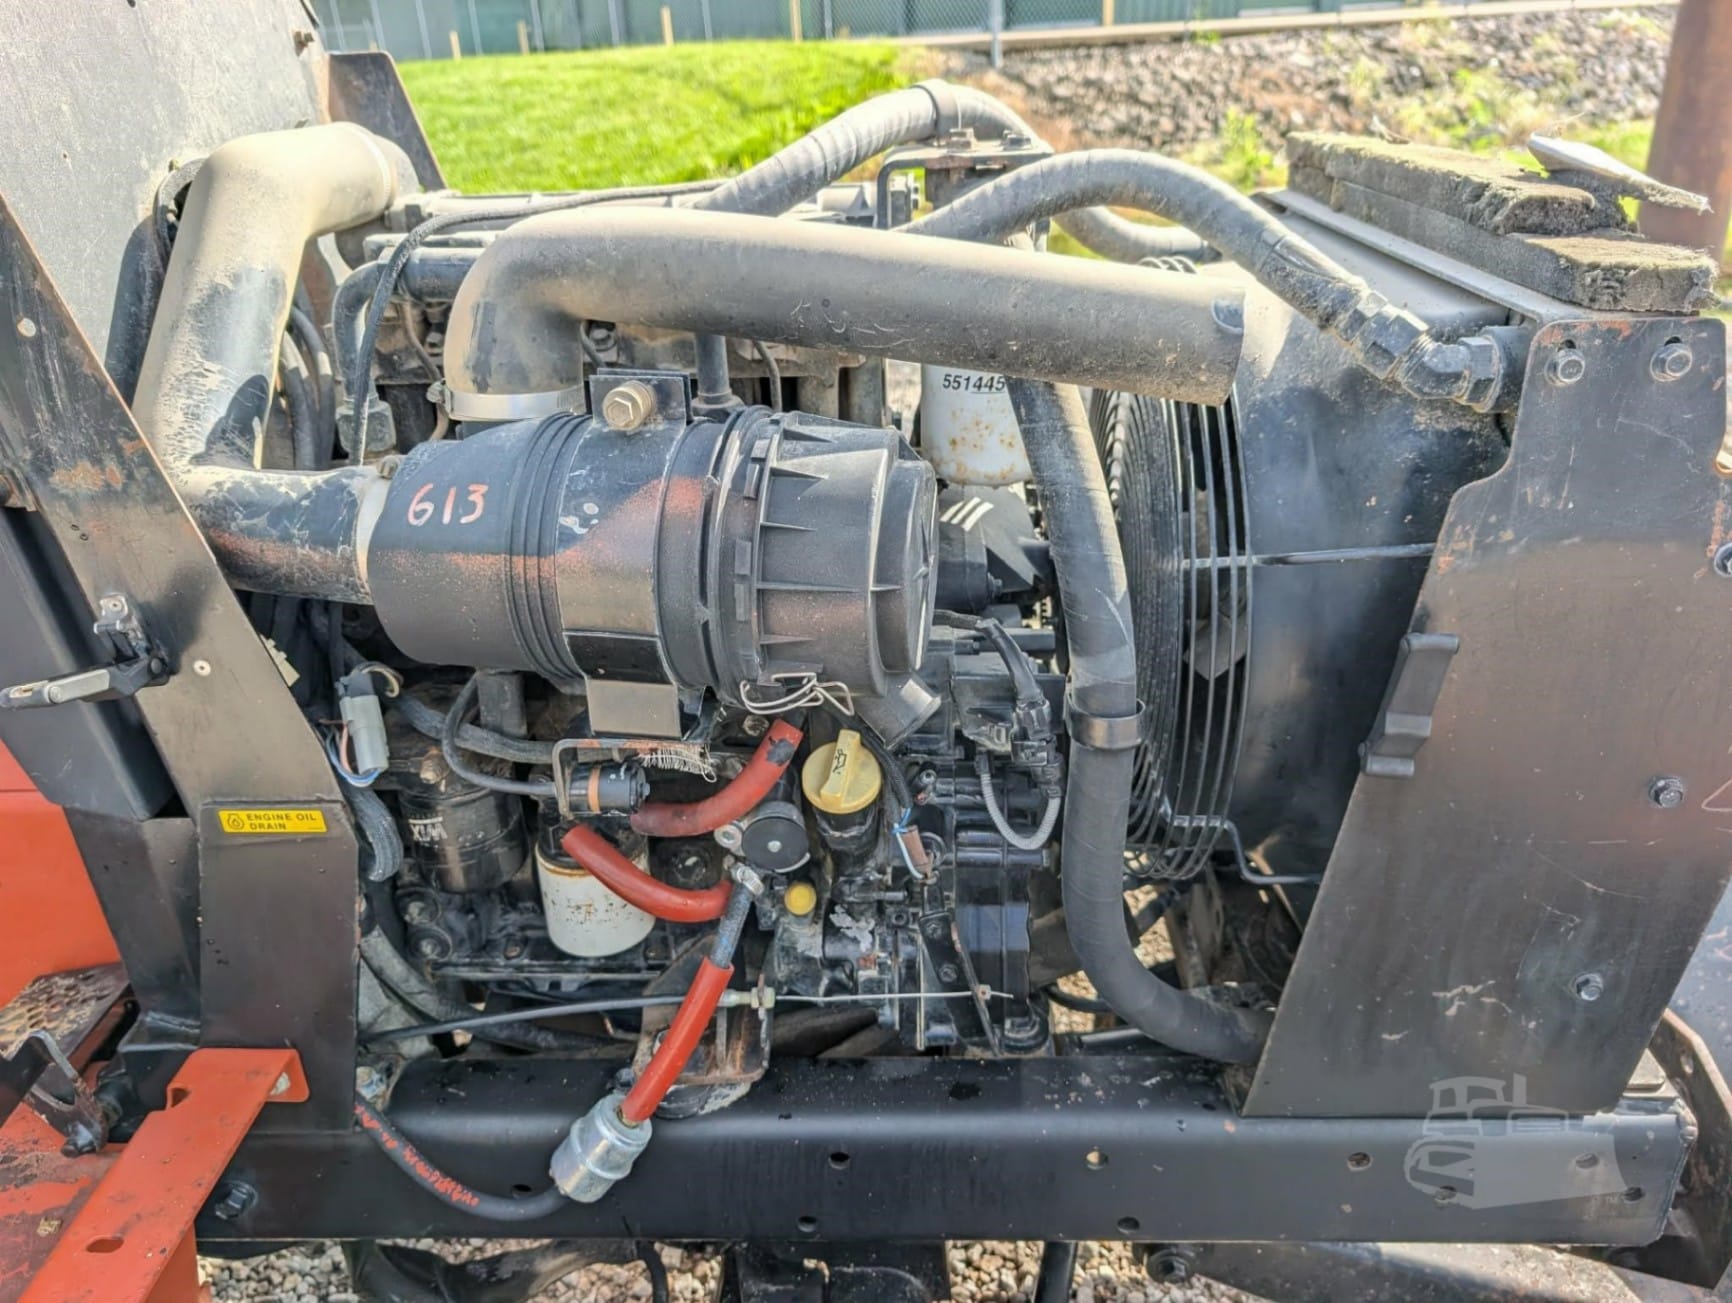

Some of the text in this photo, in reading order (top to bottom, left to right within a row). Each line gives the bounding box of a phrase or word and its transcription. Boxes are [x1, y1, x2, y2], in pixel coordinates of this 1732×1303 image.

[942, 373, 1005, 392] 551445
[407, 482, 489, 527] 613
[245, 812, 317, 821] ENGINE OIL
[249, 822, 287, 831] DRAIN
